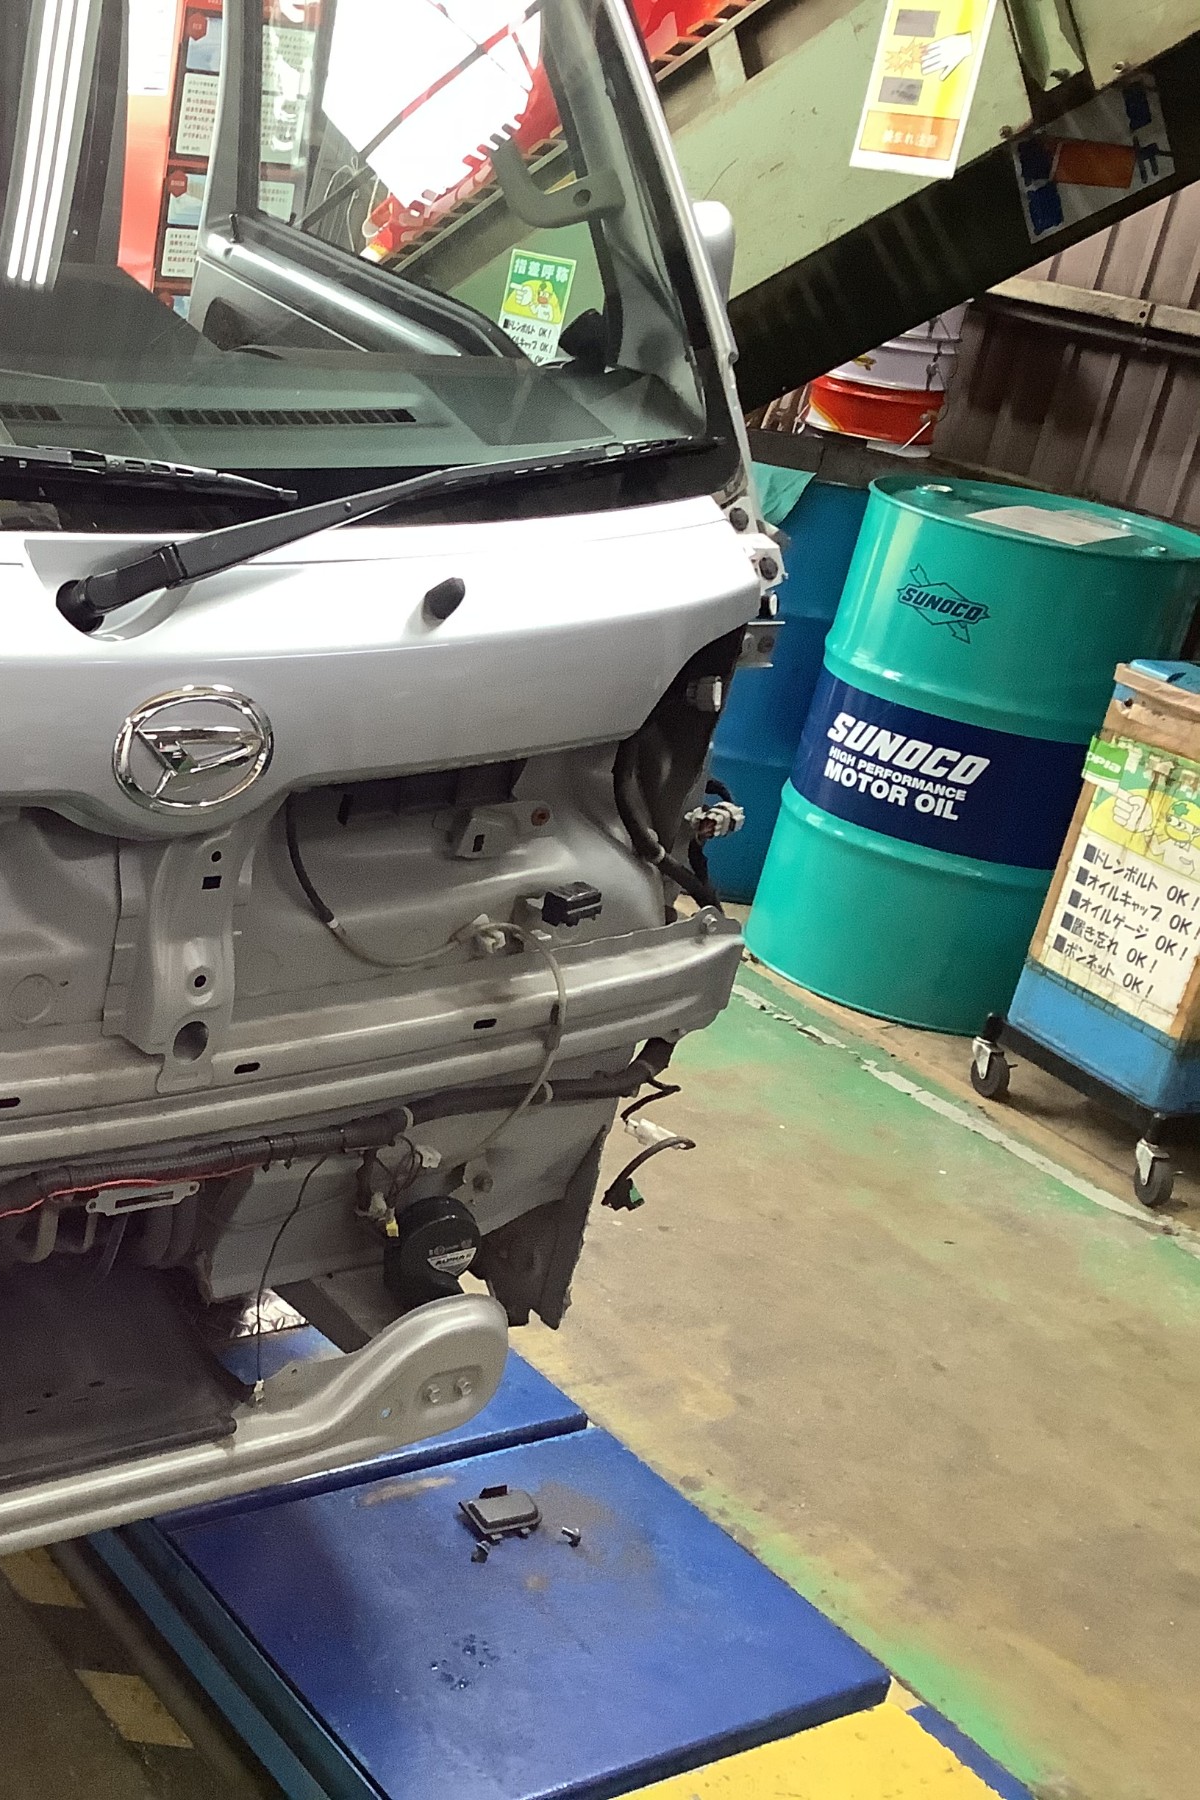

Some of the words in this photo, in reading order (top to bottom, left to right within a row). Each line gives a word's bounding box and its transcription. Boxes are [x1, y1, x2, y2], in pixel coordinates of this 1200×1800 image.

[513, 258, 569, 283] 指差呼称
[901, 586, 984, 622] SUNOCO
[826, 711, 990, 786] SUNOCO
[823, 758, 909, 807] MOTOR
[915, 794, 960, 822] OIL
[828, 746, 856, 768] HIGH
[857, 761, 967, 802] PERFORMANCE
[1166, 885, 1200, 912] OK!
[1071, 917, 1118, 956] 置き忘れ
[1126, 947, 1158, 974] OK!
[1155, 935, 1189, 961] OK!
[1122, 972, 1154, 998] OK!
